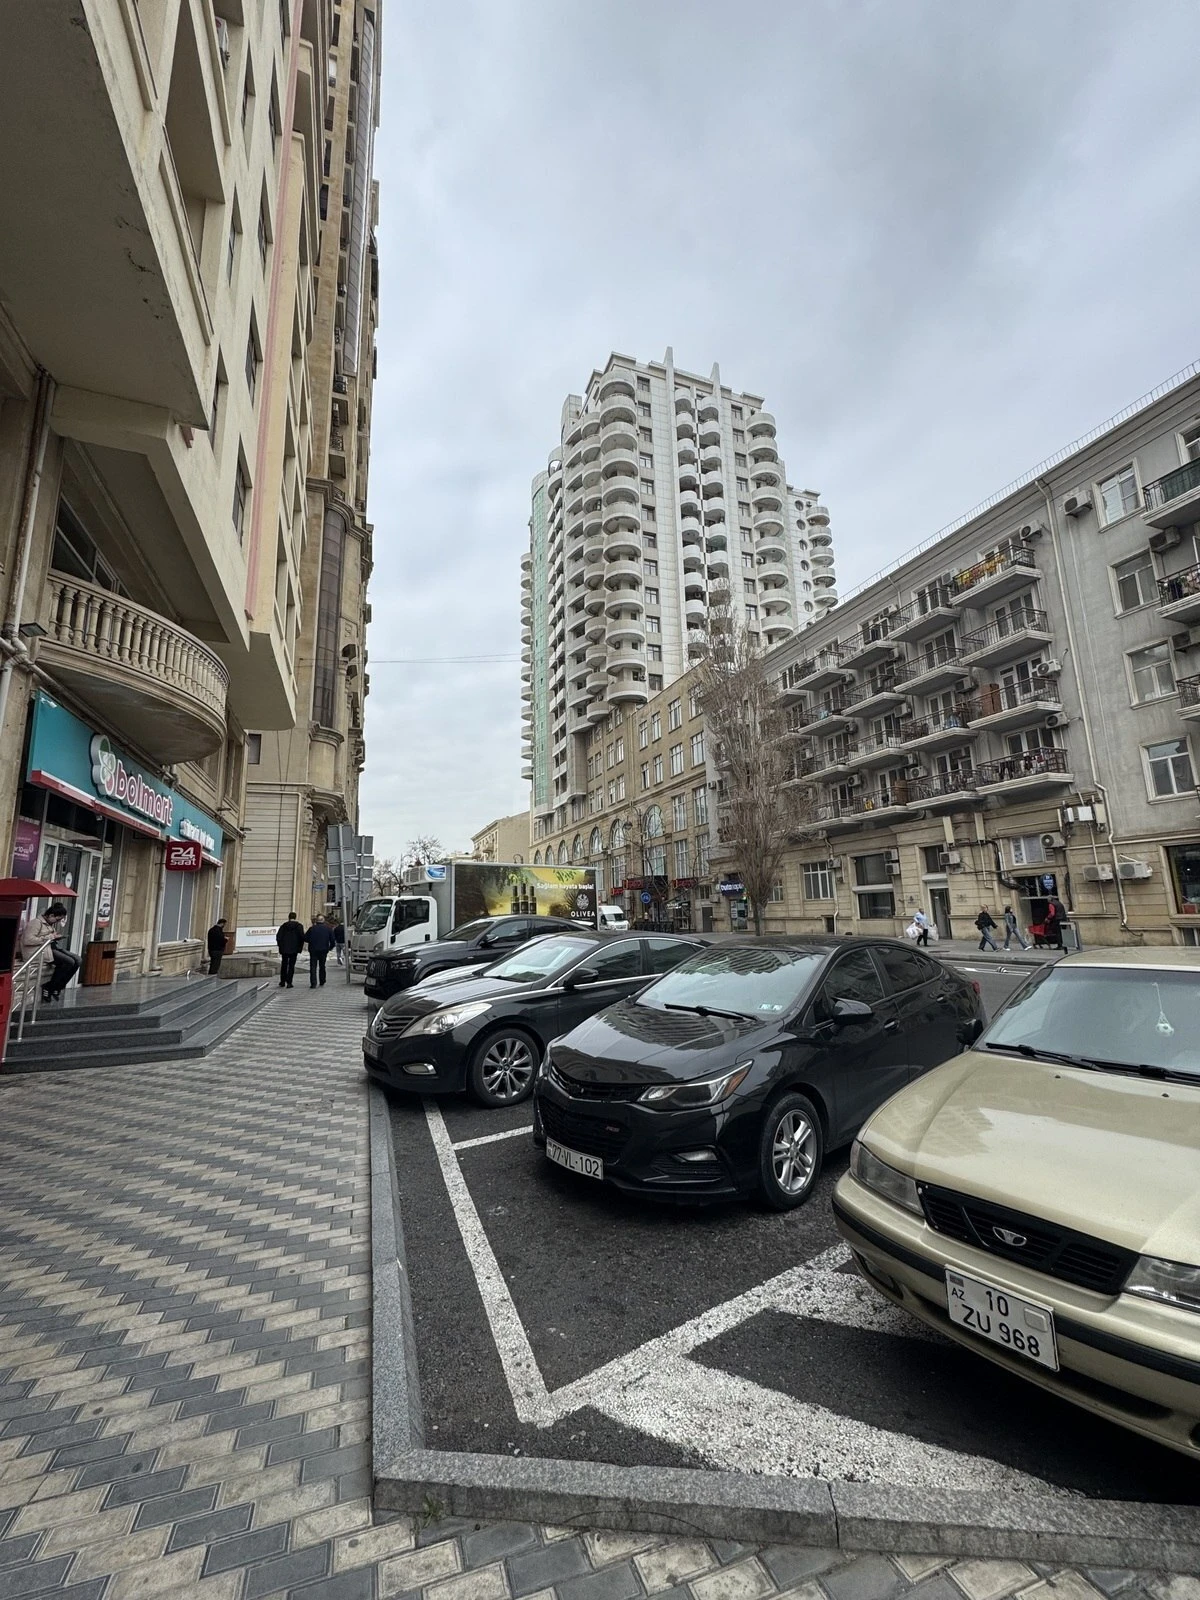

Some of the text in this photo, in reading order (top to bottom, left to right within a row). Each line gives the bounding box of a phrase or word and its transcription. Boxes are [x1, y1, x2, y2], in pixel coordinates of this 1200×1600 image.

[115, 759, 173, 827] bolmart
[170, 847, 196, 860] 24
[170, 857, 196, 866] saat
[570, 910, 596, 918] OLIVEA
[951, 1287, 966, 1302] AZ
[985, 1290, 1009, 1317] 10
[961, 1303, 1040, 1358] ZU 968
